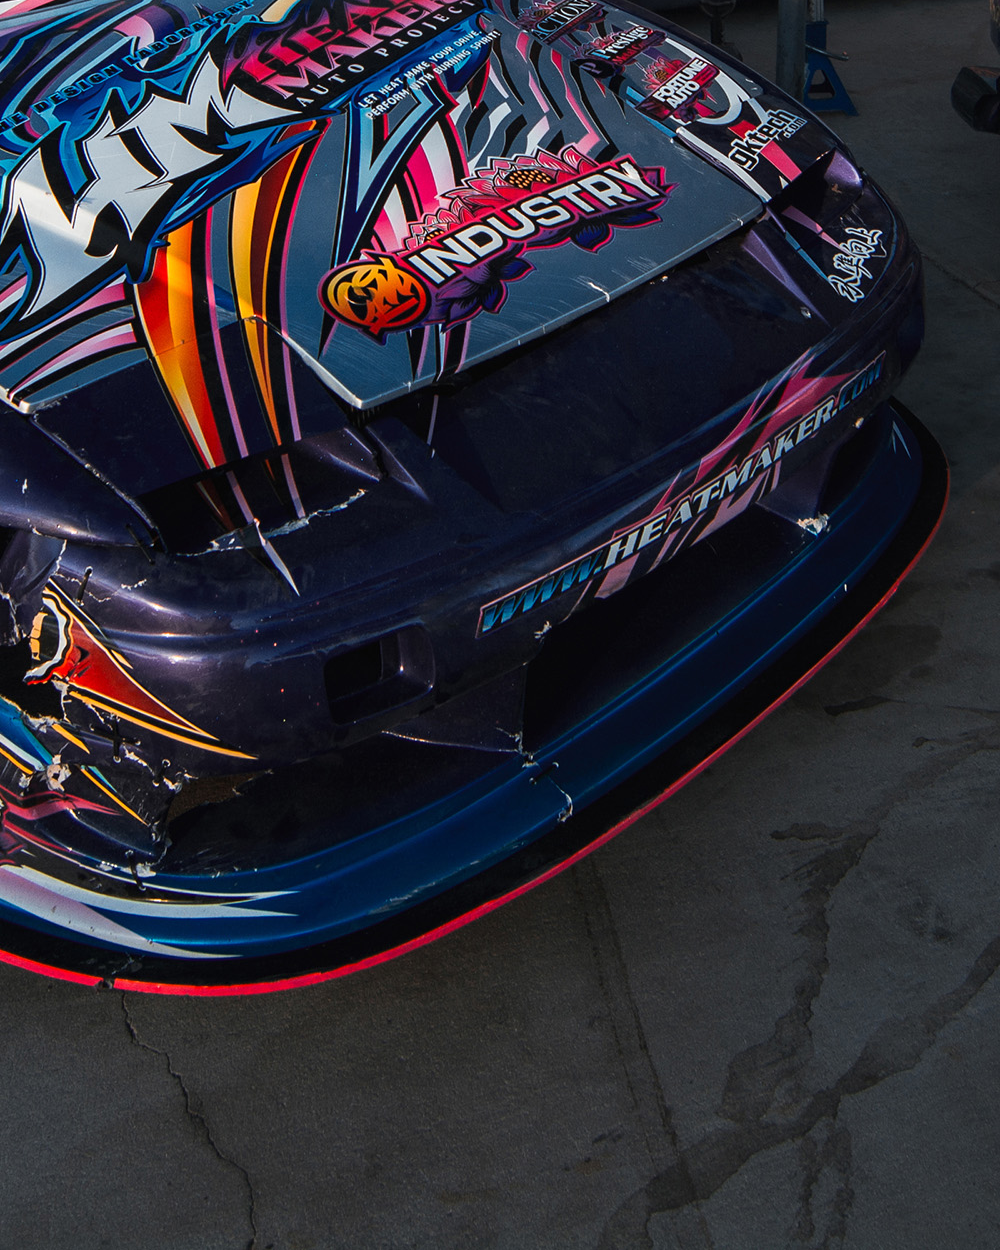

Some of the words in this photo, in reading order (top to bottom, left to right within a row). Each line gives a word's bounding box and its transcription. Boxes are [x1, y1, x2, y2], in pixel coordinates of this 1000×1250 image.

[31, 63, 124, 115] DESIGN
[296, 63, 365, 108] AUTO
[358, 93, 379, 110] LET
[378, 77, 405, 98] HEAT
[403, 60, 432, 80] MAKE
[428, 45, 455, 65] YOUR
[453, 30, 483, 48] DRIVE.
[366, 87, 412, 120] PERFORM
[409, 72, 436, 92] WITH
[432, 49, 472, 76] BURNING
[470, 29, 502, 51] SPIRIT!
[651, 58, 709, 103] FORTUNE
[665, 79, 701, 110] AUTO
[727, 109, 798, 172] gktech
[406, 160, 657, 287] INDUSTRY
